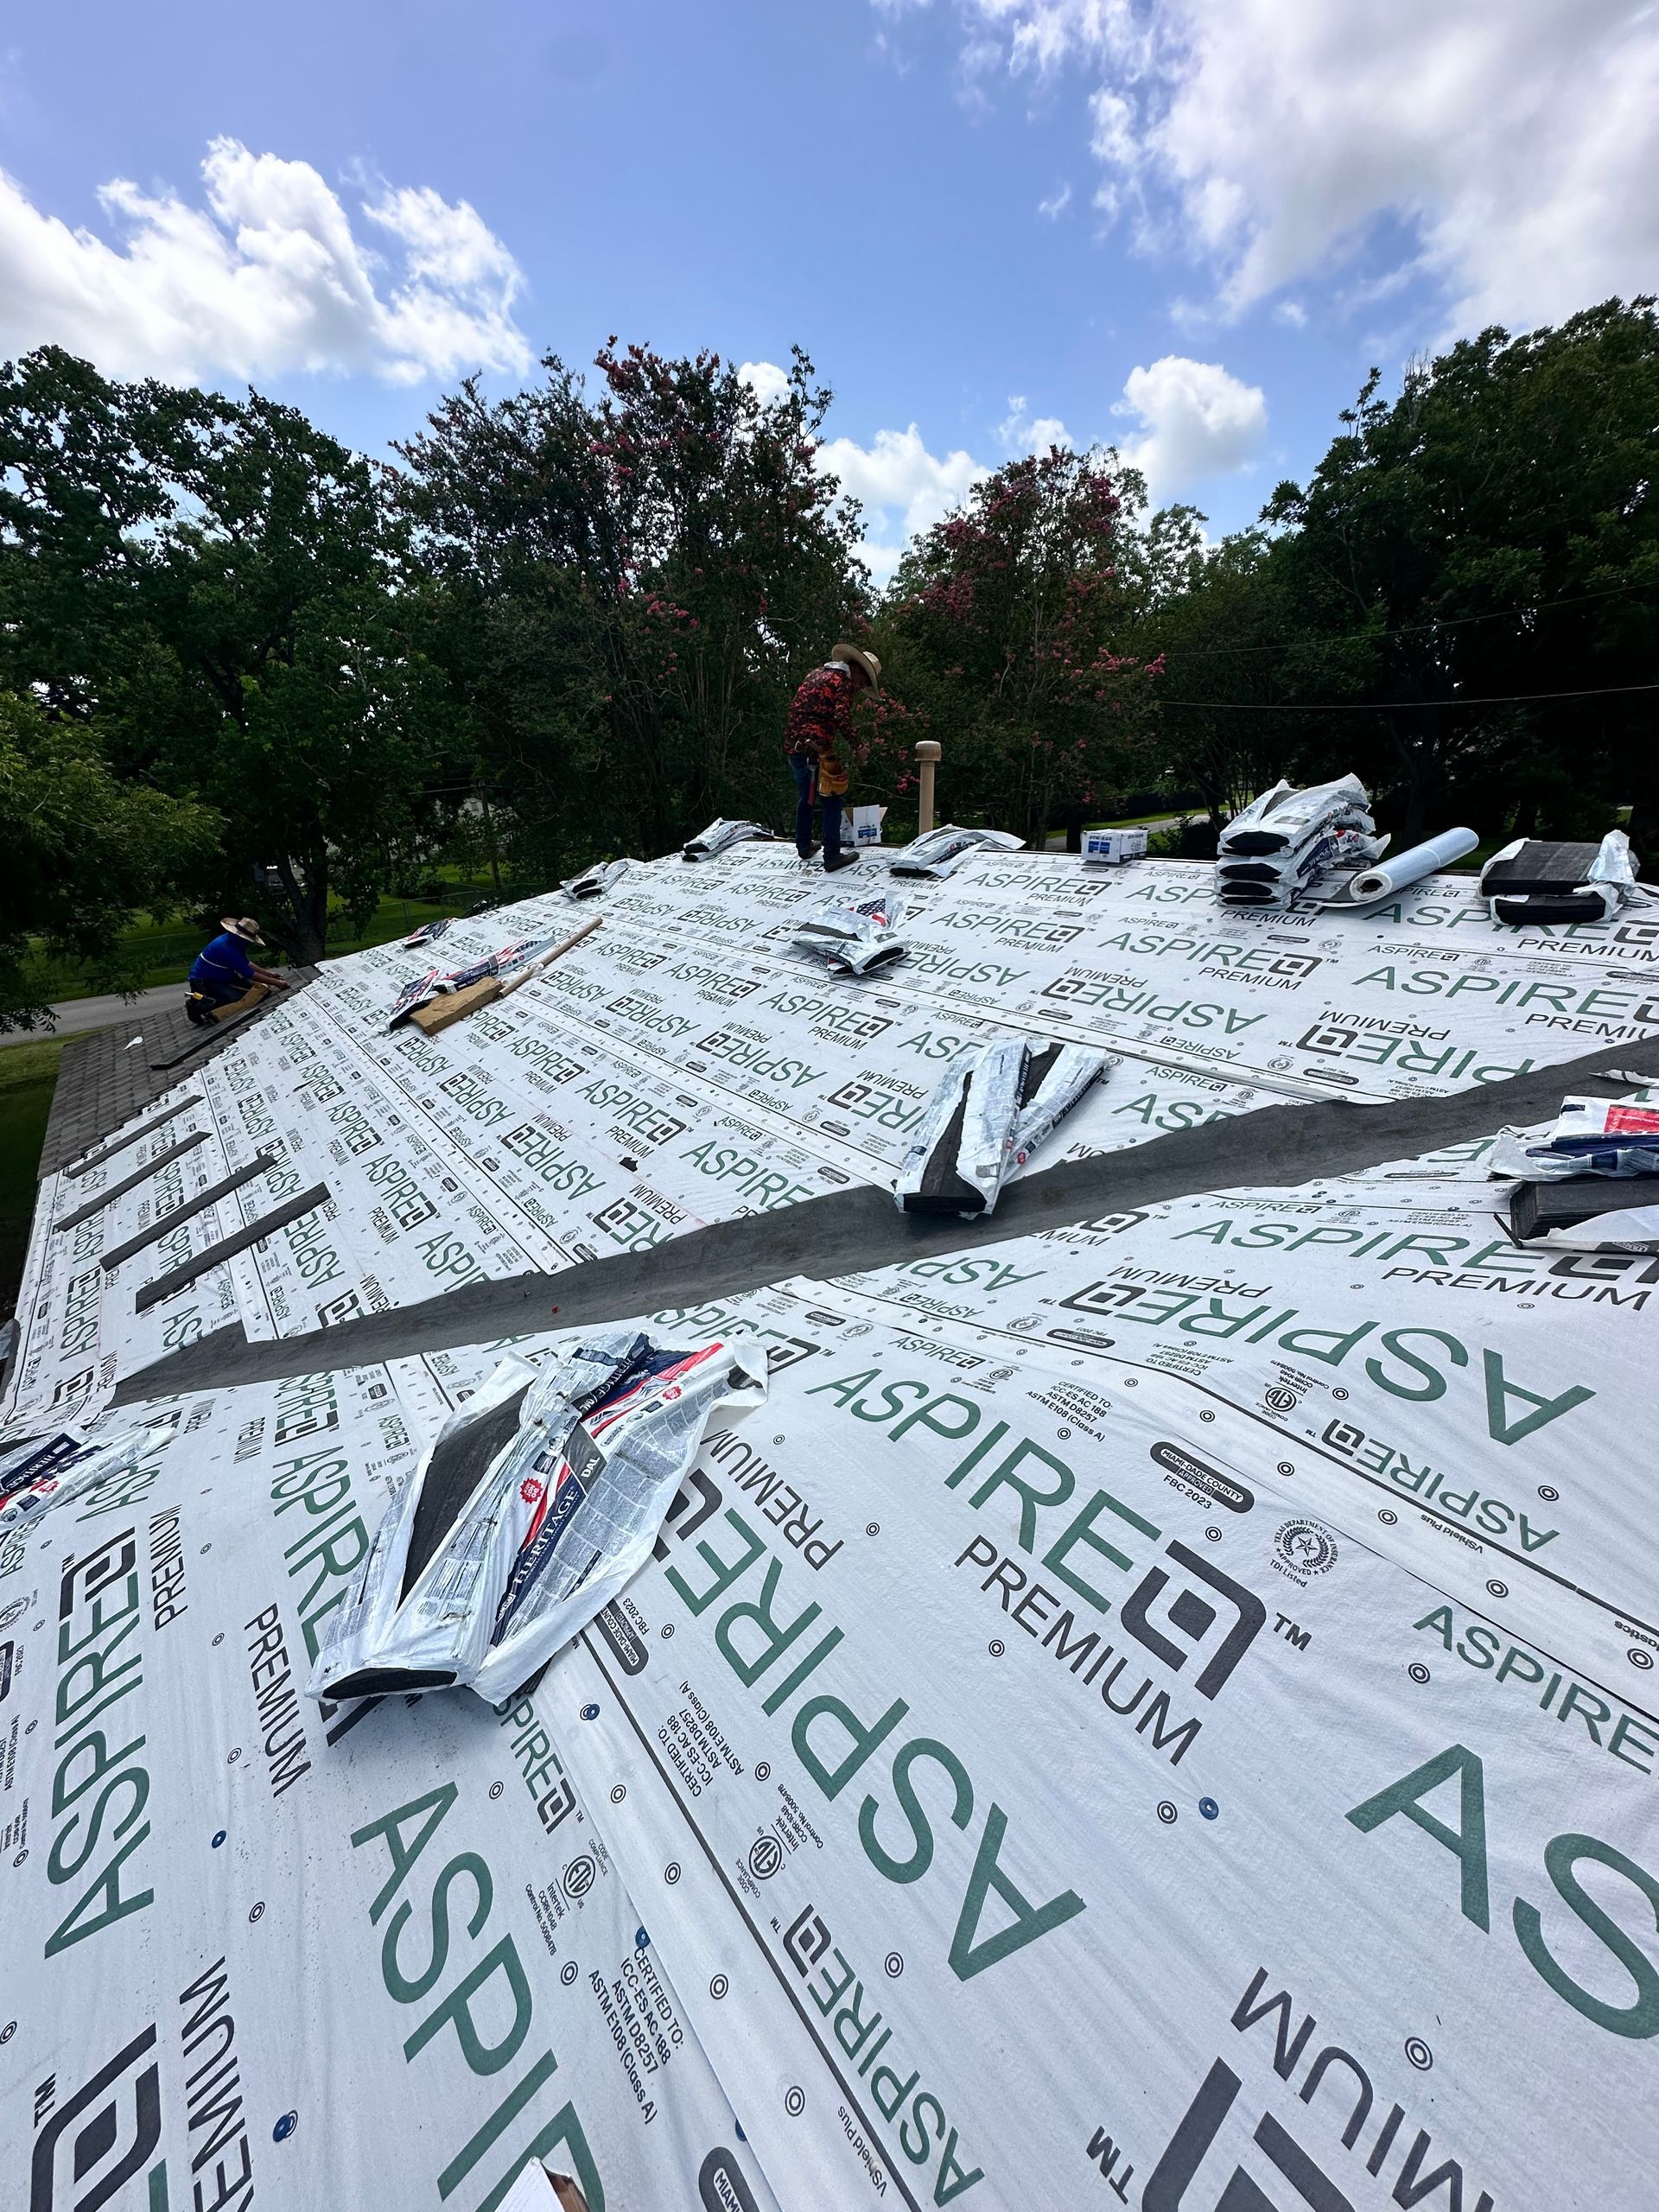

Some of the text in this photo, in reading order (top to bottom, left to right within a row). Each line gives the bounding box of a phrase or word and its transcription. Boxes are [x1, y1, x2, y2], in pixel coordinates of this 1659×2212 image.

[658, 874, 711, 890] ASPIRE
[727, 882, 795, 902] ASPIRE
[963, 873, 1080, 893] ASPIRE
[1027, 893, 1094, 906] PREMIUM
[688, 912, 765, 932] ASPIRE
[930, 912, 1049, 940] ASPIRE
[1118, 917, 1168, 929] ASPIRE
[1220, 909, 1316, 927] PREMIUM
[594, 943, 646, 968] ASPIRE
[995, 938, 1064, 953] PREMIUM
[1096, 932, 1277, 971] ASPIRE
[1367, 944, 1442, 960] ASPIRE
[549, 973, 613, 1002] ASPIRE
[663, 963, 742, 996] ASPIRE
[1065, 966, 1148, 988] PREMIUM
[1198, 966, 1302, 990] PREMIUM
[1351, 966, 1638, 1020] ASPIRE
[694, 989, 738, 1007] PREMIUM
[760, 991, 870, 1032] ASPIRE
[1071, 980, 1268, 1034] ASPIRE
[615, 999, 701, 1039] ASPIRE
[722, 1021, 772, 1044] PREMIUM
[1318, 1010, 1452, 1041] PREMIUM
[508, 1036, 568, 1077] ASPIRE
[809, 1027, 868, 1050] PREMIUM
[1173, 1039, 1240, 1060] ASPIRE
[404, 1039, 454, 1077] ASPIRE
[711, 1039, 828, 1088] ASPIRE
[522, 1071, 557, 1094] PREMIUM
[856, 1069, 930, 1099] PREMIUM
[1145, 1066, 1211, 1089] ASPIRE
[449, 1078, 516, 1127] ASPIRE
[575, 1079, 669, 1135] ASPIRE
[756, 1090, 793, 1112] ASPIRE
[325, 1101, 370, 1147] ASPIRE
[532, 1114, 572, 1141] PREMIUM
[606, 1126, 654, 1159] PREMIUM
[718, 1116, 753, 1137] ASPIRE
[327, 1139, 350, 1166] PREMIUM
[512, 1132, 607, 1200] ASPIRE
[361, 1154, 427, 1219] ASPIRE
[629, 1184, 688, 1225] PREMIUM
[368, 1206, 400, 1244] PREMIUM
[1208, 1200, 1300, 1213] ASPIRE
[1170, 1219, 1545, 1273] ASPIRE
[1107, 1266, 1273, 1298] PREMIUM
[1381, 1267, 1652, 1312] PREMIUM
[913, 1295, 985, 1318] ASPIRE
[60, 1291, 101, 1363] ASPIRE
[888, 1336, 960, 1366] ASPIRE
[1114, 1289, 1597, 1446] ASPIRE
[597, 1358, 635, 1397] HERITAGE
[1058, 1381, 1114, 1410] CERTIFIED TO:
[1279, 1376, 1308, 1394] Intertek
[1025, 1390, 1106, 1442] ASTM E108 (Class A)
[1046, 1391, 1097, 1423] ASTM D8257
[1051, 1385, 1108, 1418] ICC-ES AC 188
[234, 1417, 265, 1464] PREMIUM
[804, 1368, 1162, 1615] ASPIRE
[1162, 1449, 1243, 1501] MIAMI-DADE COUNTY
[1163, 1474, 1212, 1510] FBC 2023
[1178, 1470, 1211, 1494] APPROVED
[701, 1428, 843, 1571] PREMIUM
[1357, 1437, 1561, 1553] ASPIRE
[513, 1457, 600, 1584] HERITAGE DAL
[1274, 1525, 1287, 1543] TEXAS
[1284, 1519, 1328, 1535] DEPARTMENT
[1421, 1514, 1484, 1554] VShield Plus
[149, 1503, 188, 1631] PREMIUM
[1269, 1559, 1308, 1588] TDI Listed
[1277, 1552, 1312, 1576] APPROVED
[623, 1598, 650, 1636] FBC 2023
[613, 1626, 639, 1665] MIAMI-DADE
[954, 1535, 1203, 1766] PREMIUM
[244, 1603, 312, 1798] PREMIUM
[1412, 1605, 1656, 1776] ASPIRE
[664, 1509, 1086, 1982] ASPIRE
[679, 1681, 745, 1776] ASTM E108 (Class A)
[679, 1708, 722, 1769] ASTM D8257
[44, 1574, 155, 1960] ASPIRE
[658, 1726, 702, 1796] CERTIFIED TO:
[667, 1715, 714, 1786] ICC-ES AC 188
[776, 1815, 799, 1852] Intertek
[778, 1784, 823, 1849] Control No. 5008478
[781, 1805, 808, 1843] CCRR-1048
[588, 1839, 609, 1877] COMPLIANCE
[735, 1858, 761, 1898] COMPLIANCE
[737, 1874, 750, 1893] CODE
[525, 1884, 538, 1911] Control
[540, 1921, 557, 1956] 5008478
[538, 1890, 557, 1931] CCRR-1048
[547, 1882, 565, 1920] Intertek
[620, 1957, 671, 2065] ICC-ES AC 188
[634, 1947, 683, 2049] CERTIFIED TO:
[612, 1980, 659, 2074] ASTM D8257
[588, 1969, 658, 2125] ASTM E108 (Class A)
[807, 1948, 985, 2209] ASPIRE
[837, 2106, 857, 2141] Plus
